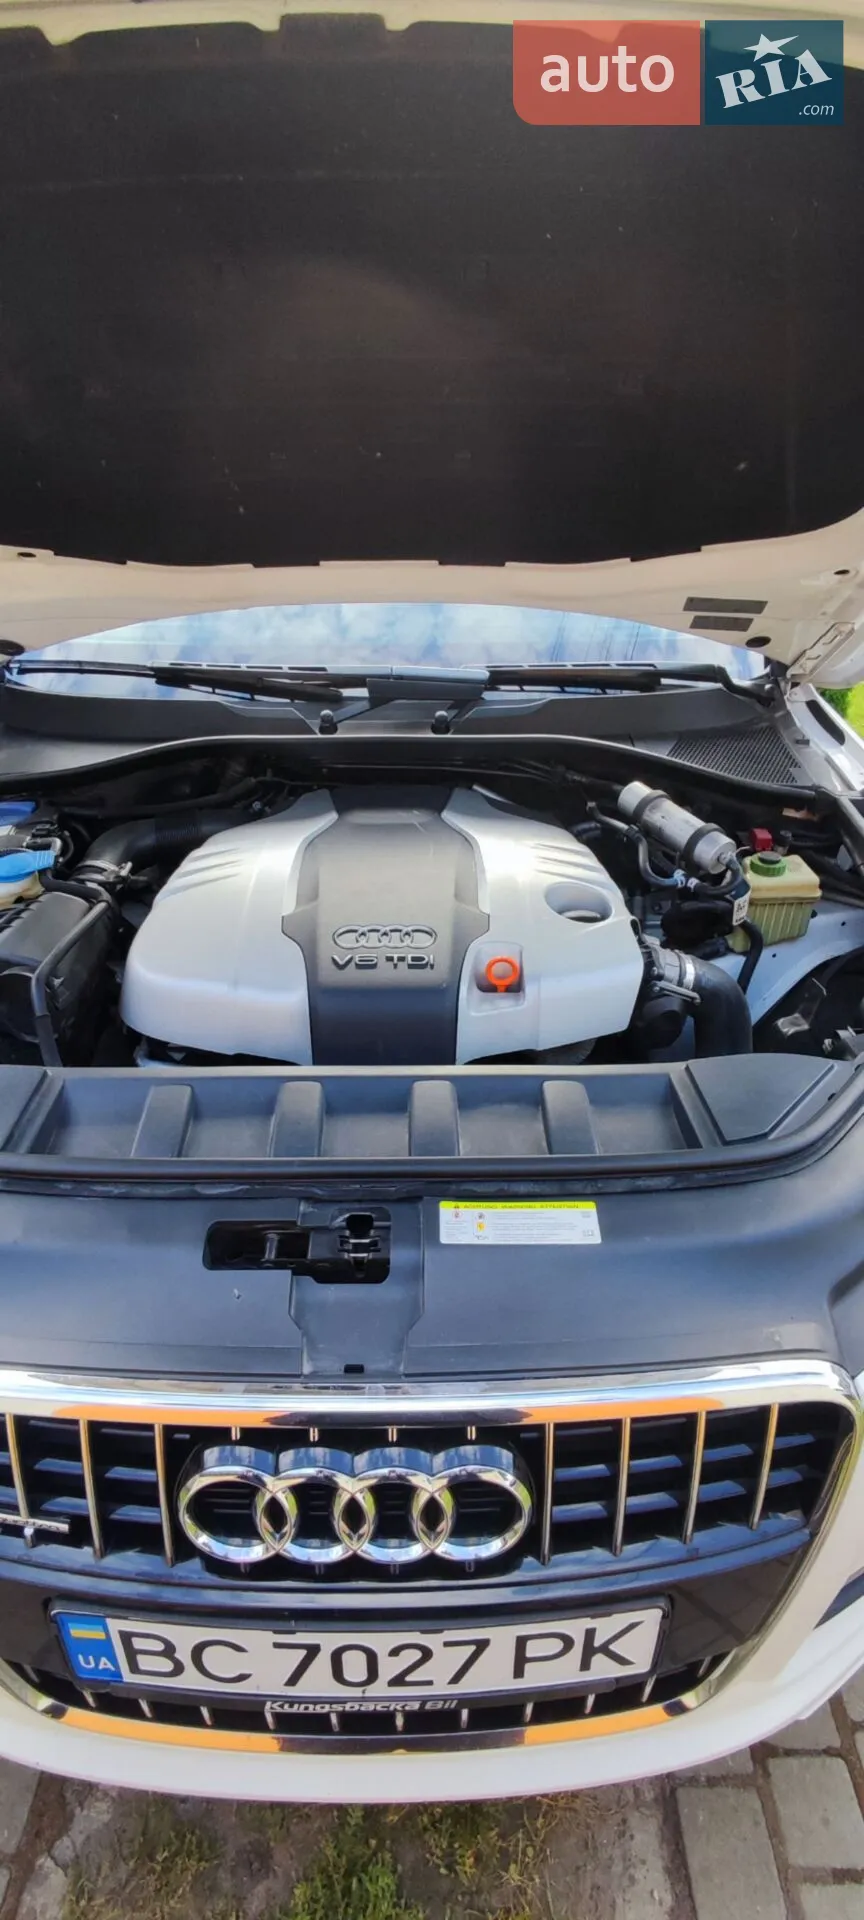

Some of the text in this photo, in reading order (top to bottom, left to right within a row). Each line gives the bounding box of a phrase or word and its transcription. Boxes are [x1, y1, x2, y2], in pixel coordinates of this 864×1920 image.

[331, 953, 435, 971] V6 TDI
[77, 1653, 116, 1672] UA
[117, 1620, 645, 1688] BC 7027 PK
